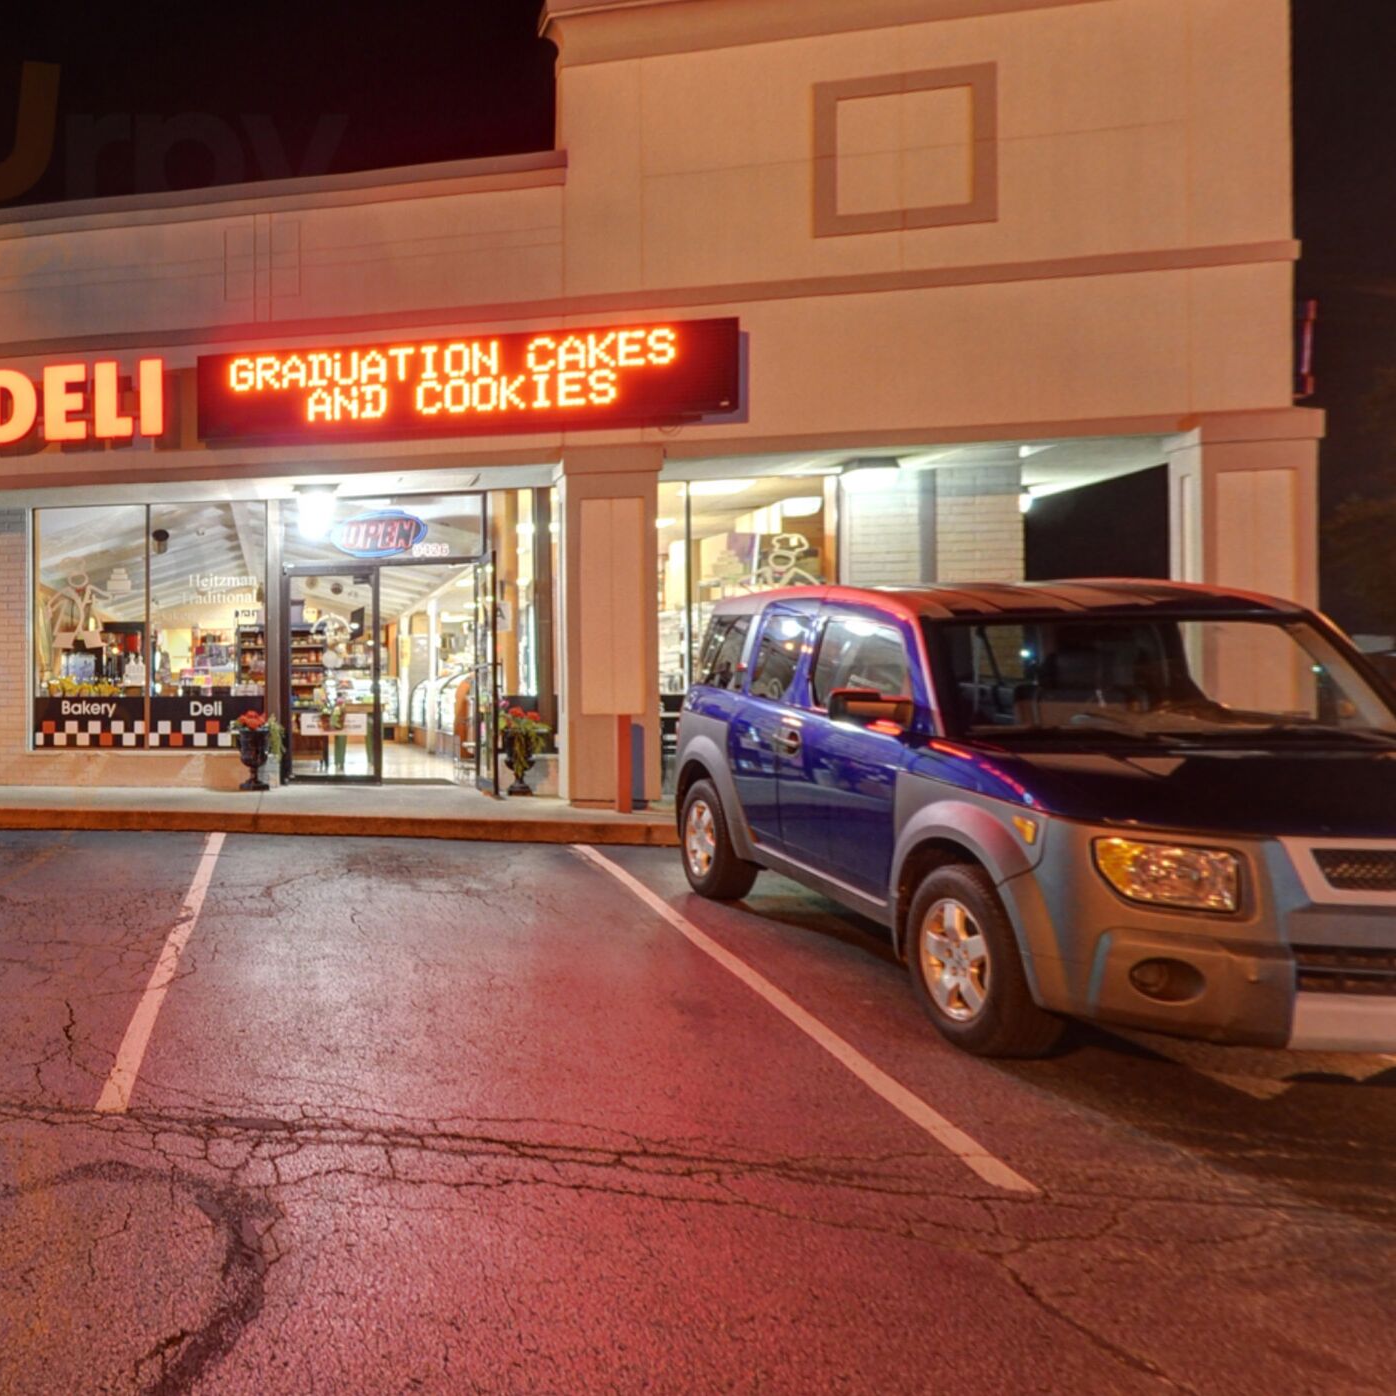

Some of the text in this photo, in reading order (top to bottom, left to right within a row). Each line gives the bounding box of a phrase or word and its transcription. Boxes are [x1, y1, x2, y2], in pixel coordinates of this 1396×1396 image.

[228, 328, 676, 392] GRADUATION CAKES
[306, 368, 618, 422] AND COOKIES
[343, 519, 416, 550] OPEN
[189, 573, 257, 588] Heitzman
[182, 588, 258, 605] Traditional
[61, 701, 116, 717] Bakery
[190, 701, 223, 717] Deli
